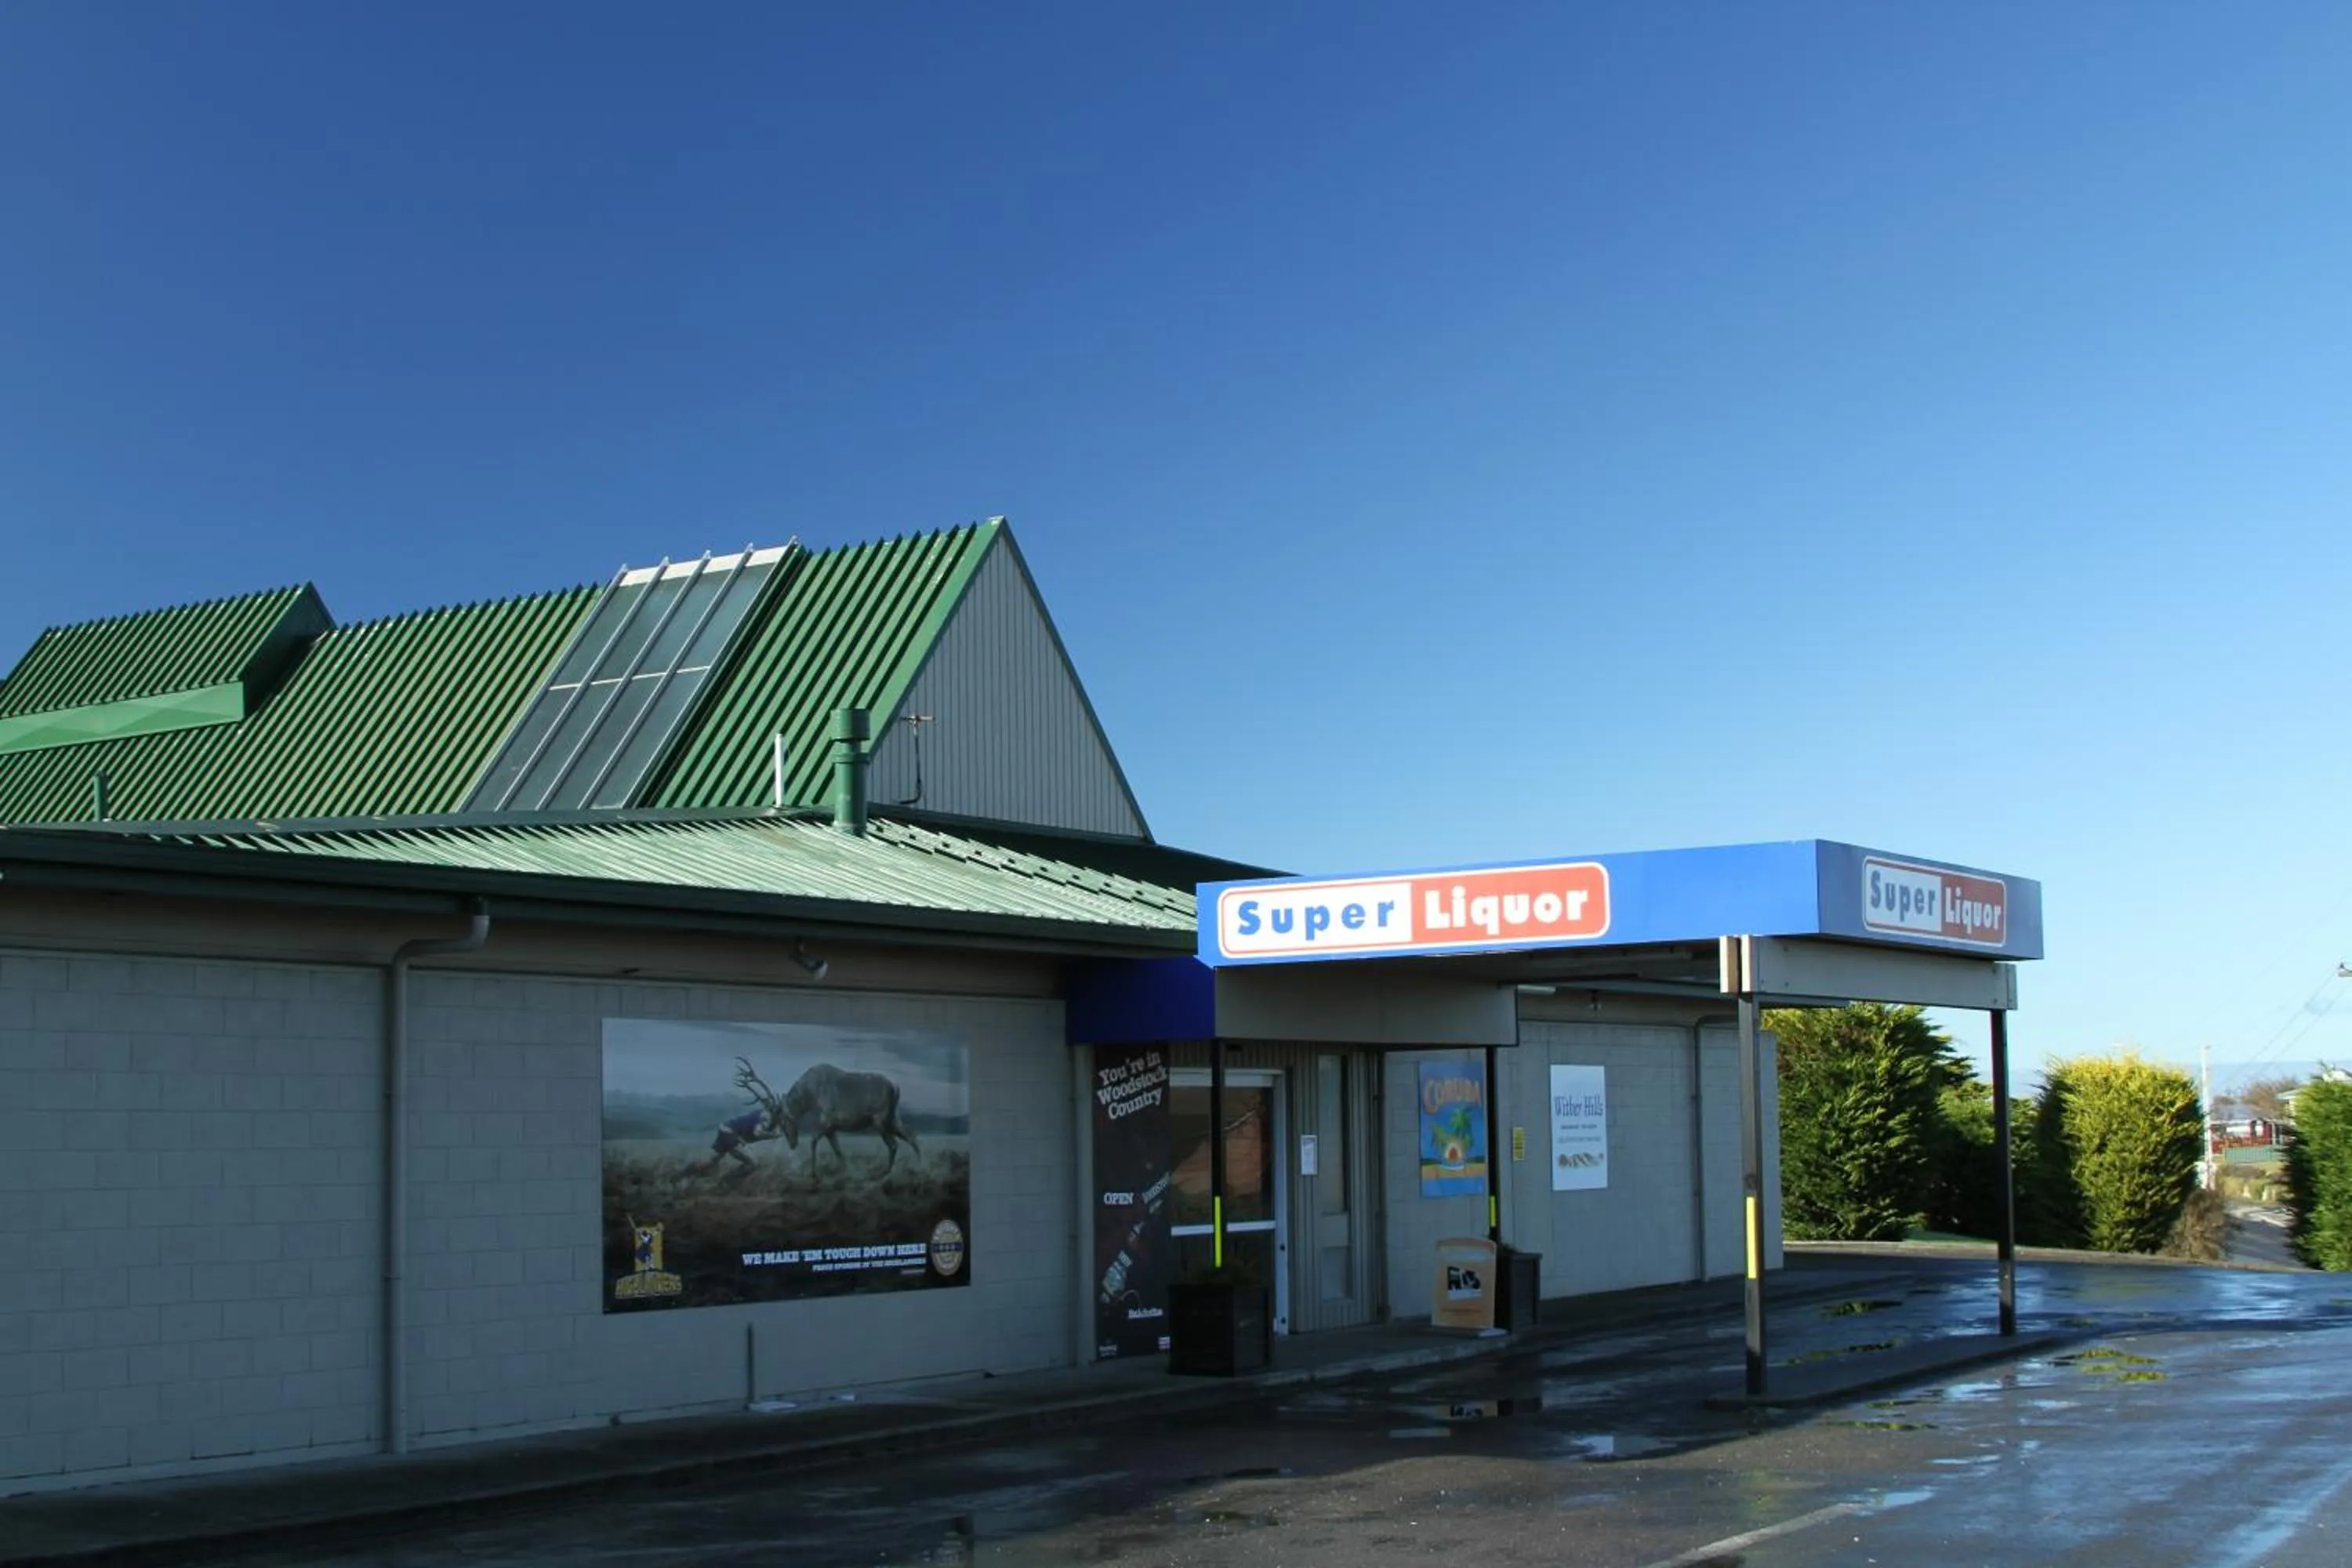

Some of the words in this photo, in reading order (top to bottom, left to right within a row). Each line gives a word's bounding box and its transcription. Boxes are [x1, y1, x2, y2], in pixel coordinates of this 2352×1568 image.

[1237, 899, 1395, 941] Super
[1425, 885, 1587, 935] Liquor
[1870, 870, 1936, 922] Super
[1944, 887, 2002, 935] Liquor
[1098, 1058, 1145, 1086] You're
[1146, 1051, 1161, 1067] in
[1098, 1065, 1168, 1105] Woodstock
[1108, 1087, 1163, 1120] Country
[1584, 1094, 1604, 1117] Hills
[1104, 1192, 1134, 1205] OPEN
[742, 1254, 761, 1265] WE
[763, 1250, 799, 1264] MAKE
[824, 1247, 861, 1260] TOUGH
[863, 1245, 895, 1258] DOWN
[897, 1243, 927, 1255] HERE
